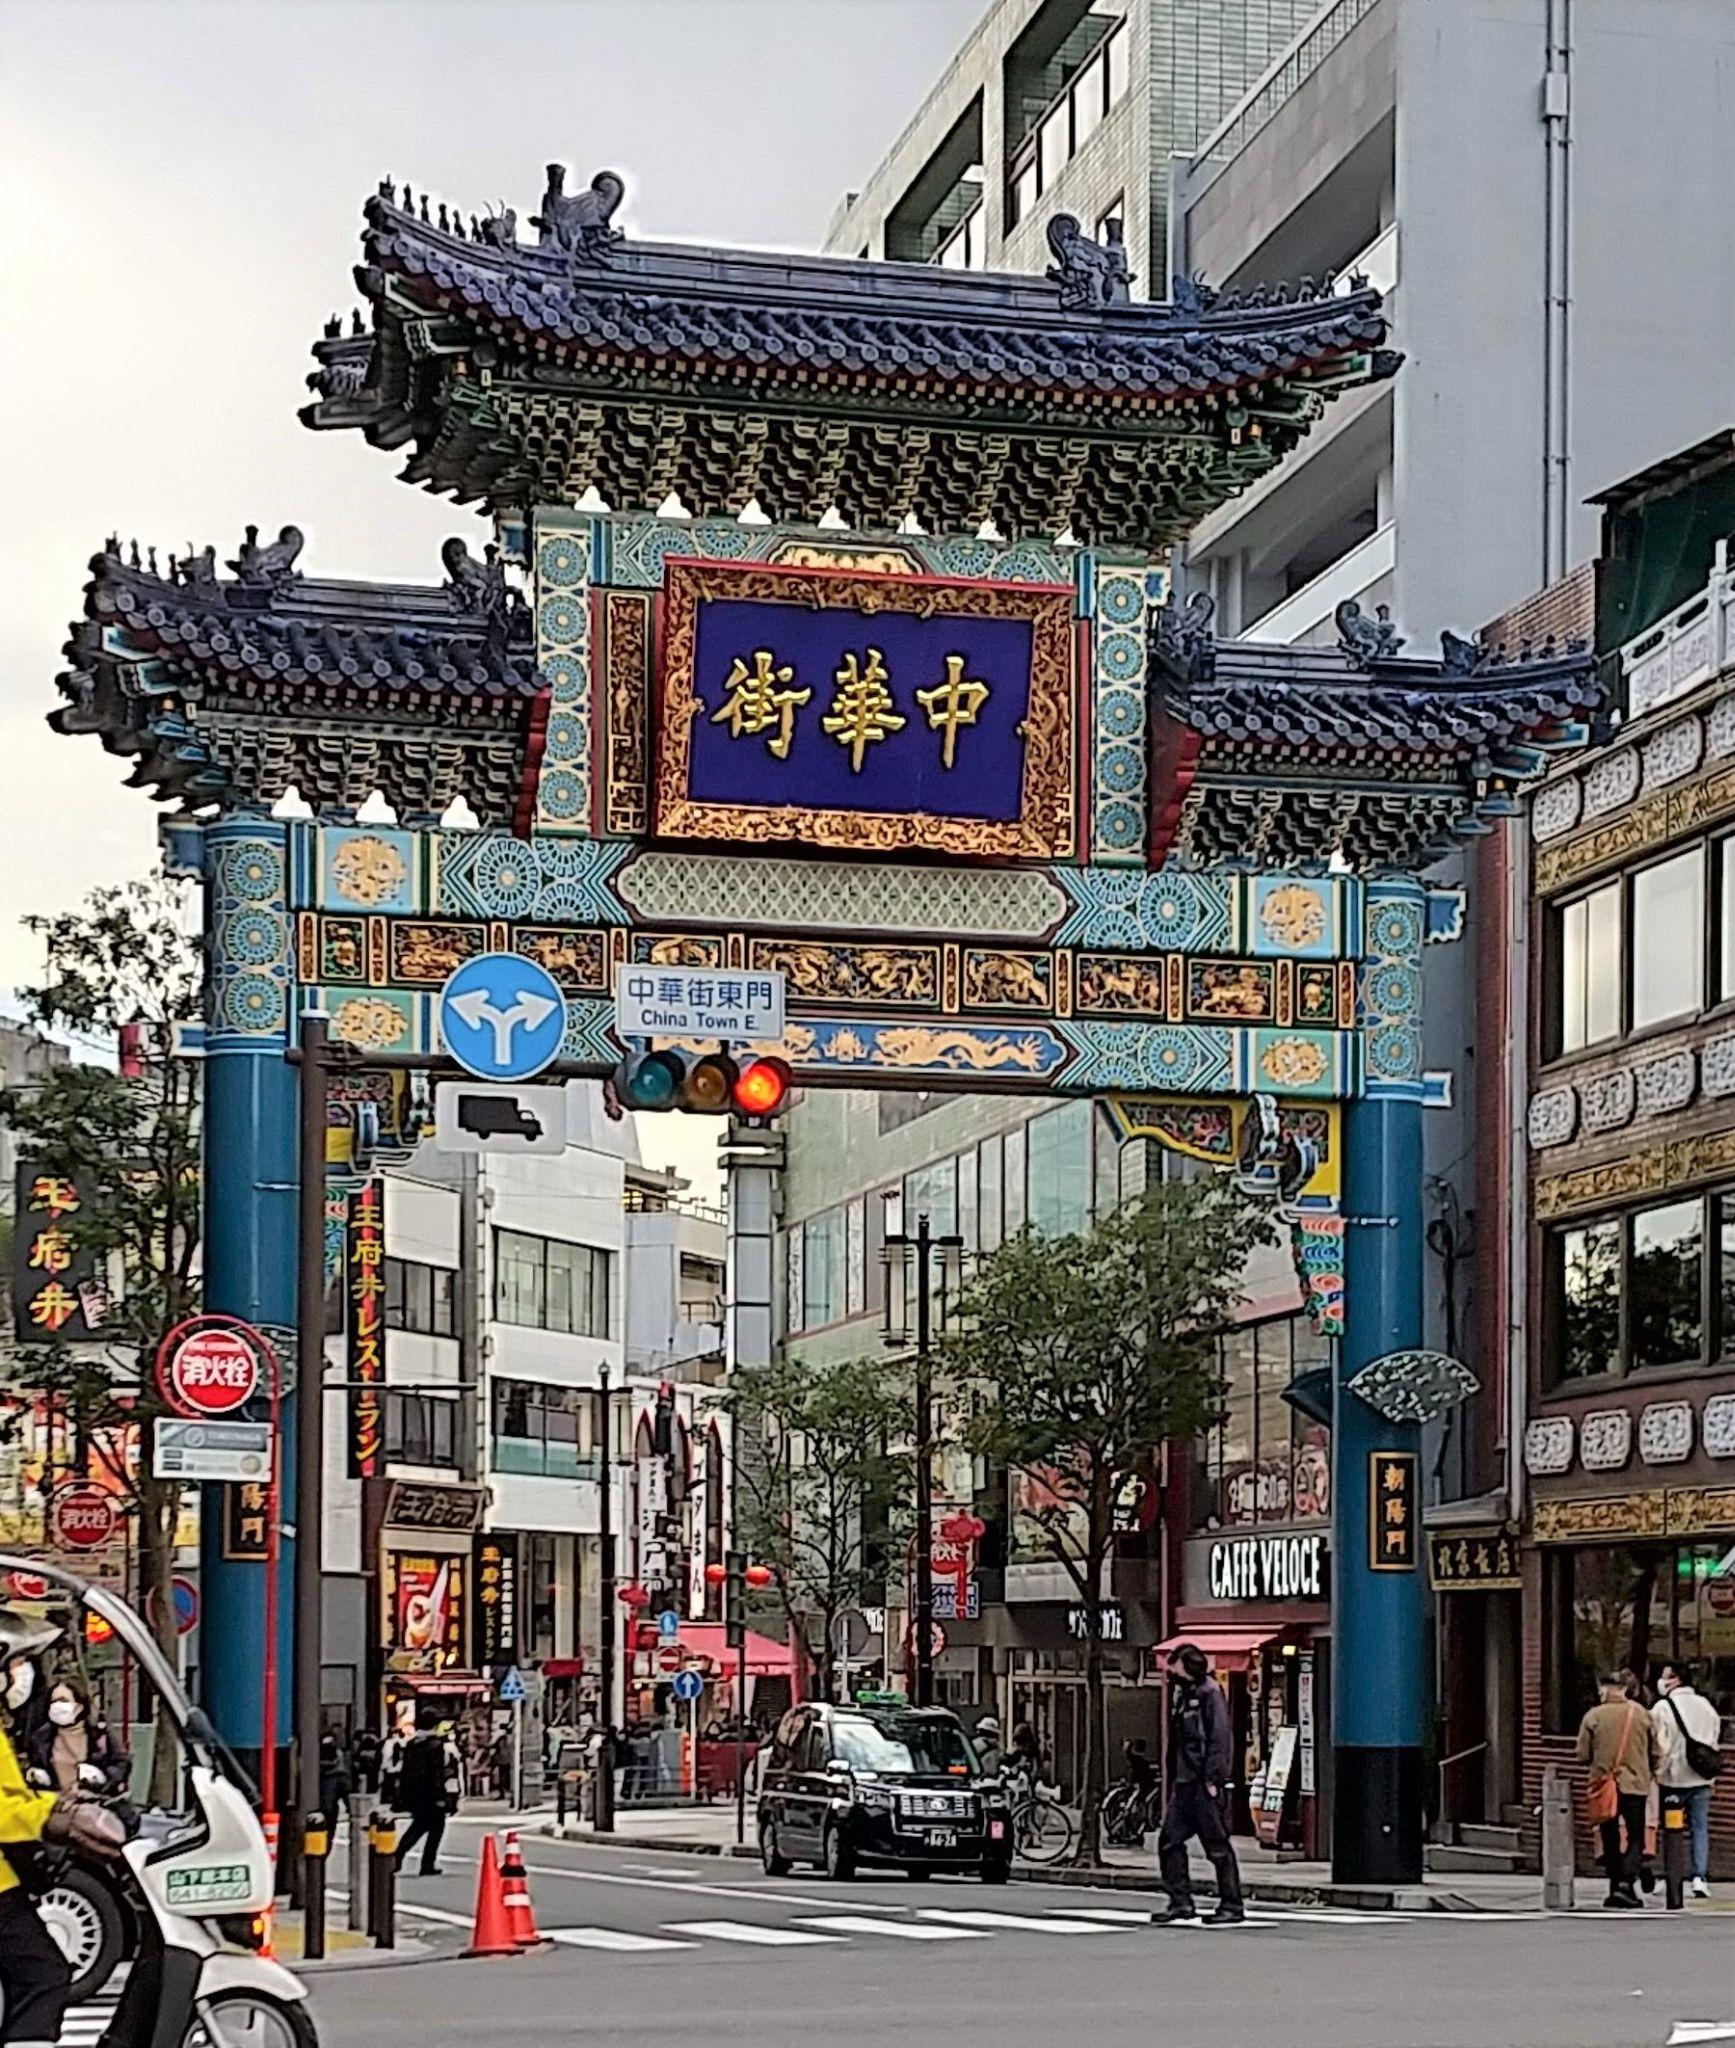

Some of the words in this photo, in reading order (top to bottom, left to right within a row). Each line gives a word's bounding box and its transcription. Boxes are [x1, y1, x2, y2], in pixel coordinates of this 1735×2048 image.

[628, 975, 773, 1011] 中華街東門
[641, 1009, 688, 1027] China
[695, 1012, 738, 1030] Town
[29, 1175, 81, 1325] 王府井
[182, 1355, 249, 1388] 消火栓
[61, 1507, 109, 1531] 消火栓
[1260, 1537, 1320, 1596] VELOCE
